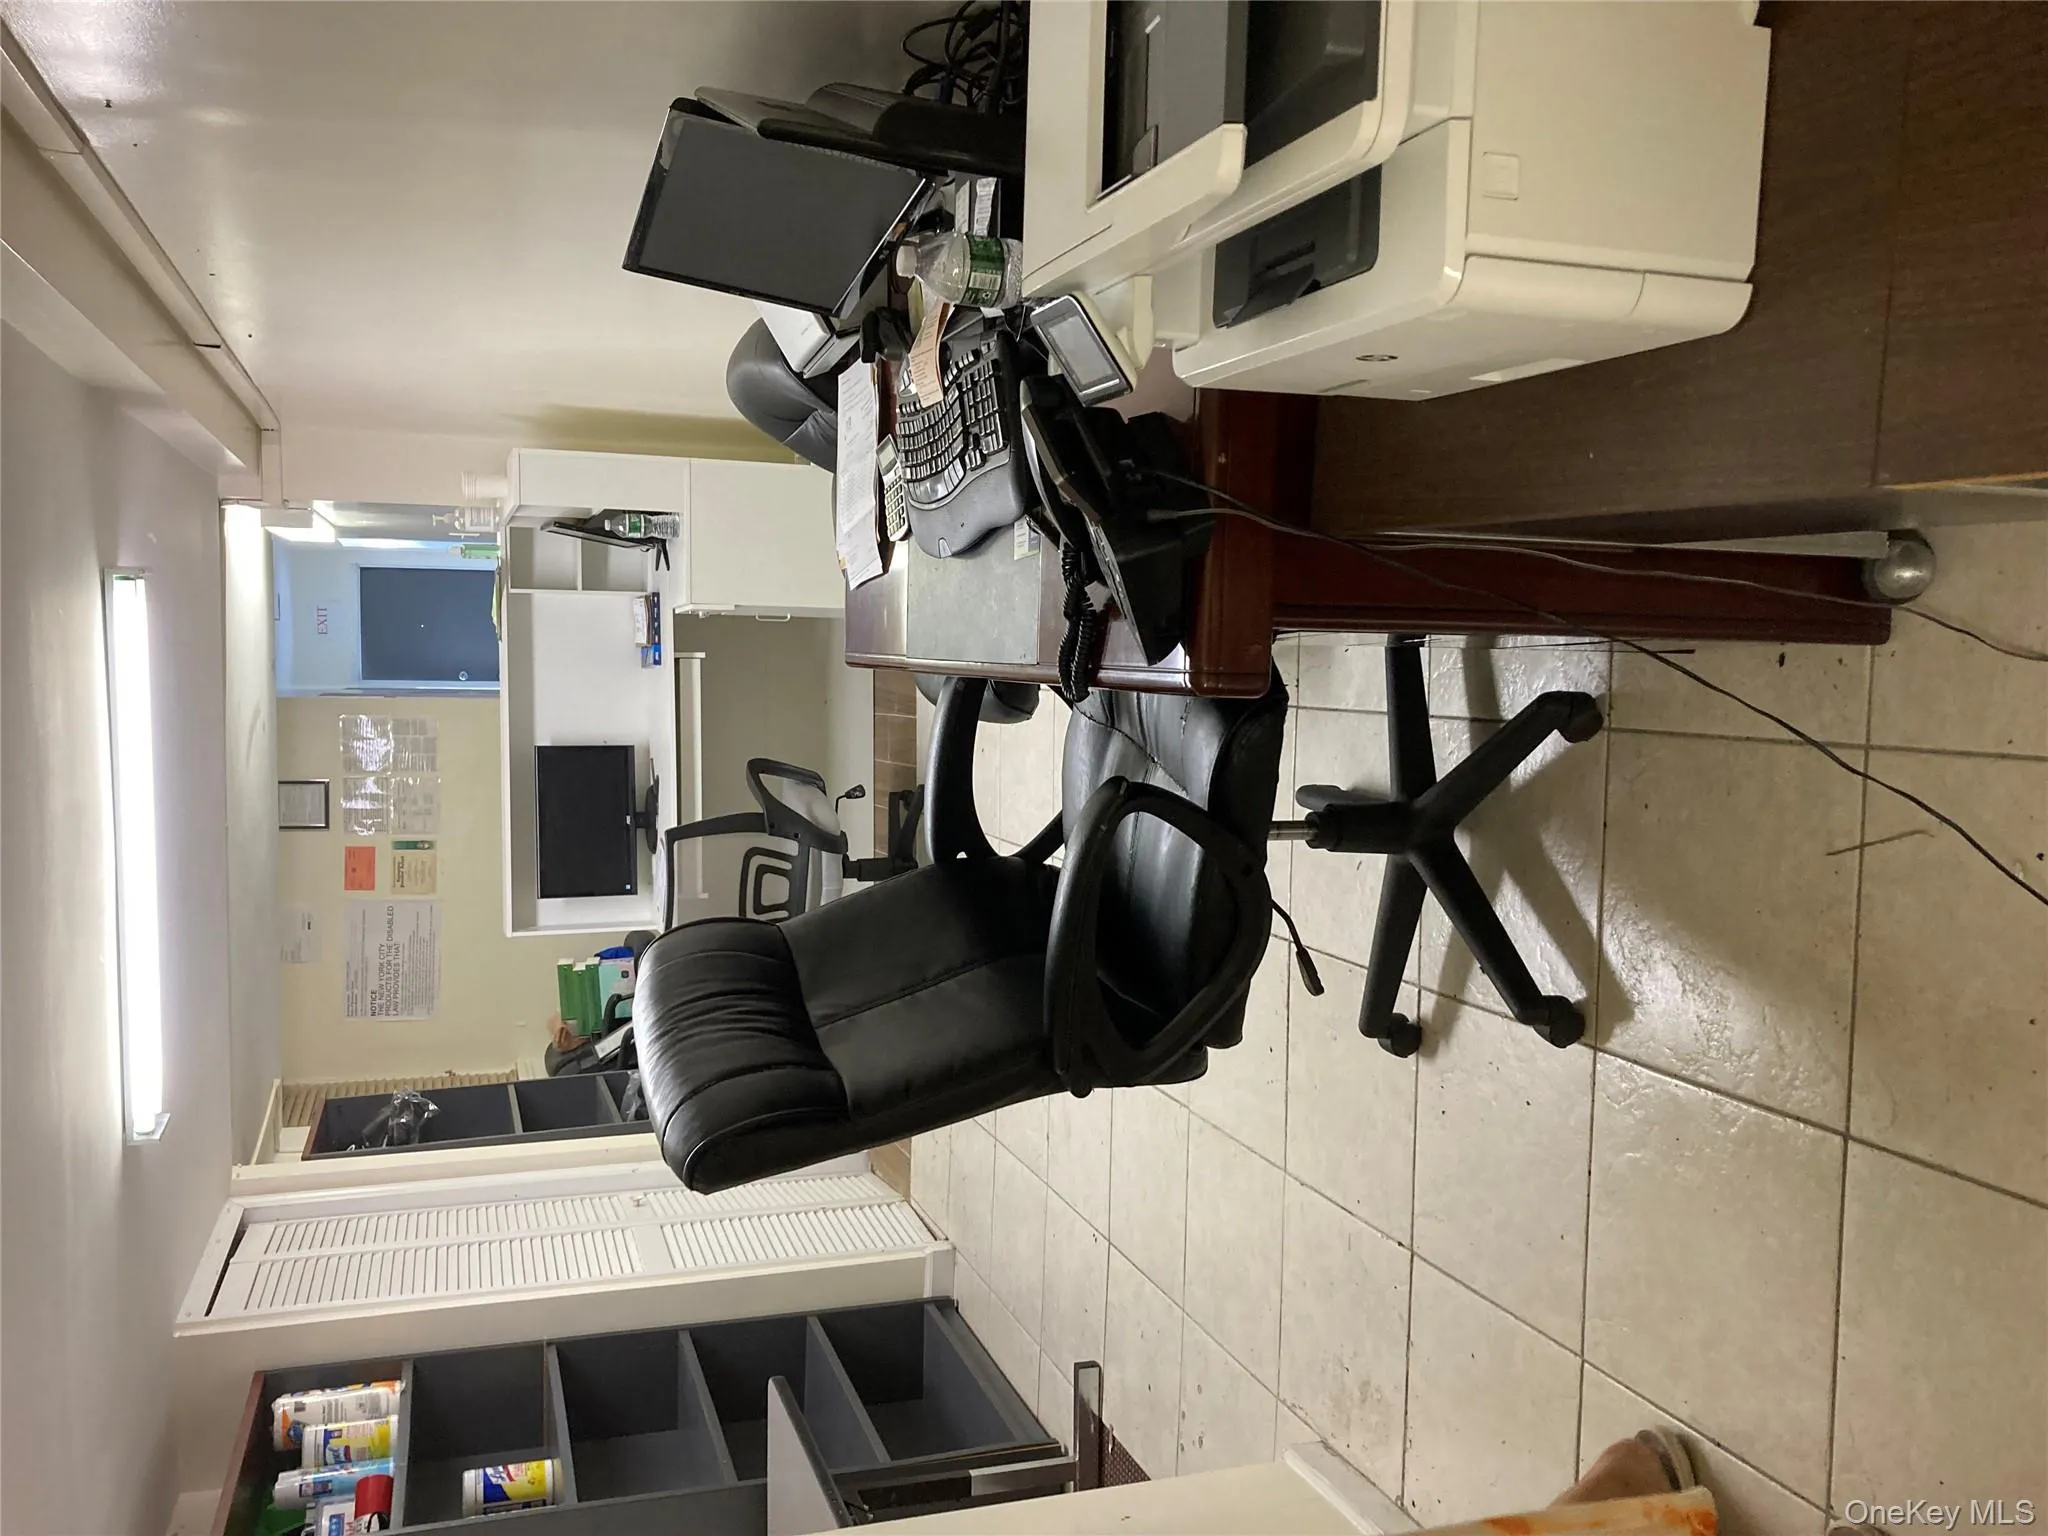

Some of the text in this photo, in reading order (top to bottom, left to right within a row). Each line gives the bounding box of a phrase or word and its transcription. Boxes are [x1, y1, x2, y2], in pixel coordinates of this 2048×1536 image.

[316, 606, 328, 635] EXIT
[386, 905, 394, 942] DISABLED
[378, 943, 386, 960] CITY
[386, 943, 394, 957] THE
[393, 943, 401, 960] THAT
[378, 961, 386, 982] YORK
[385, 976, 393, 1016] PRODUCTS
